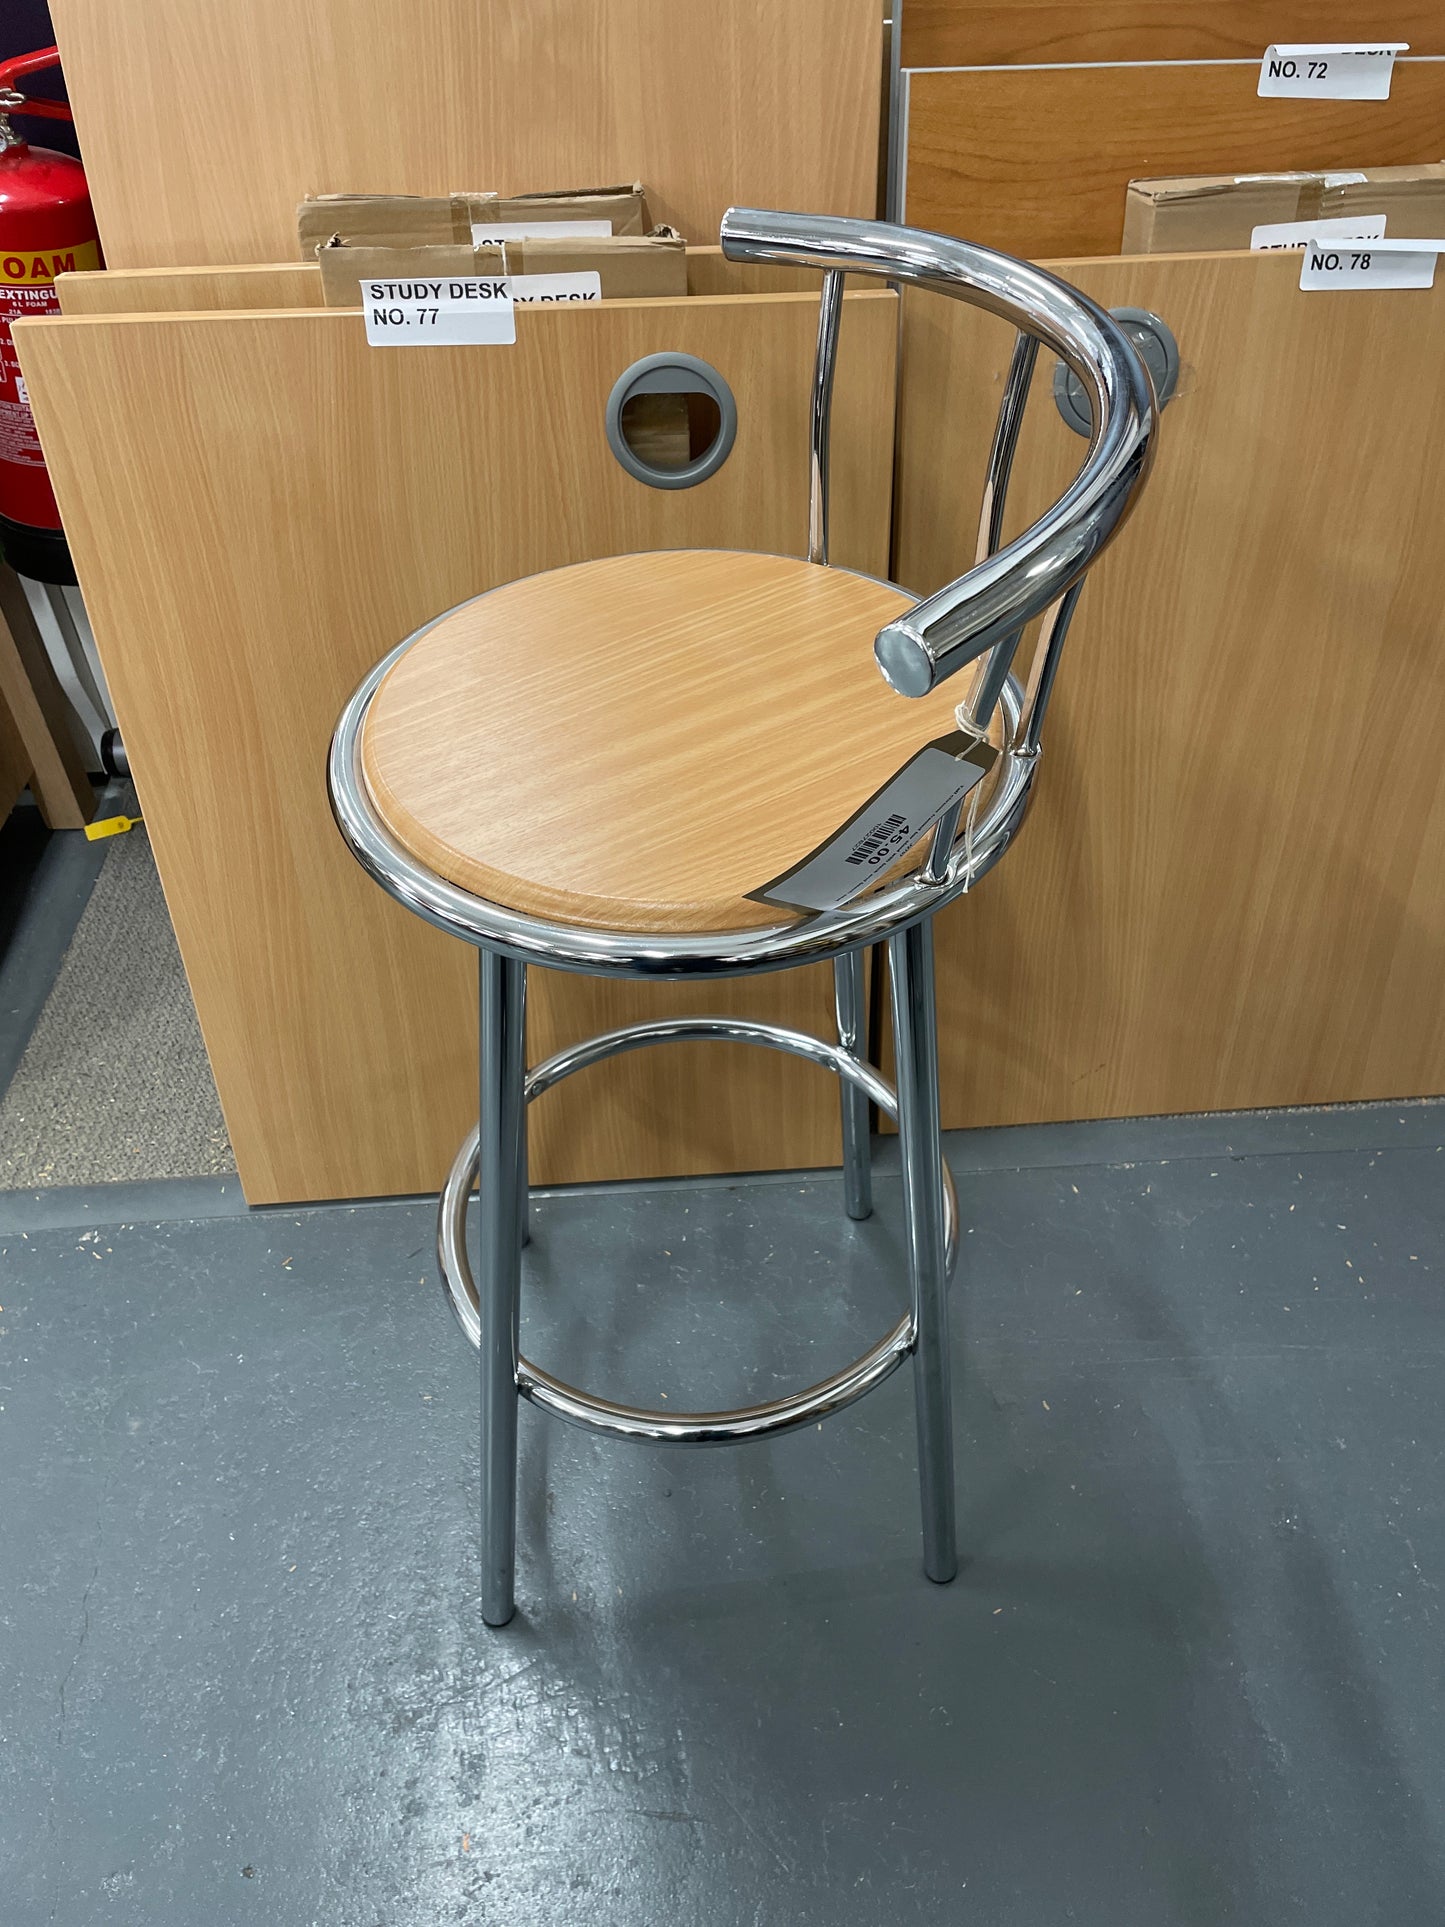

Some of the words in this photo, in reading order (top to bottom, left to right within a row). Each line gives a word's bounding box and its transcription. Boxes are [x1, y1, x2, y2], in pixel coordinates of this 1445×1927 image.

[1268, 60, 1300, 78] NO.
[1307, 62, 1328, 79] 72
[1311, 254, 1343, 271] NO.
[1351, 253, 1371, 270] 78
[371, 283, 442, 300] STUDY
[450, 282, 508, 299] DESK
[373, 308, 410, 326] NO.
[416, 308, 440, 325] 77
[867, 824, 910, 865] 45.00
